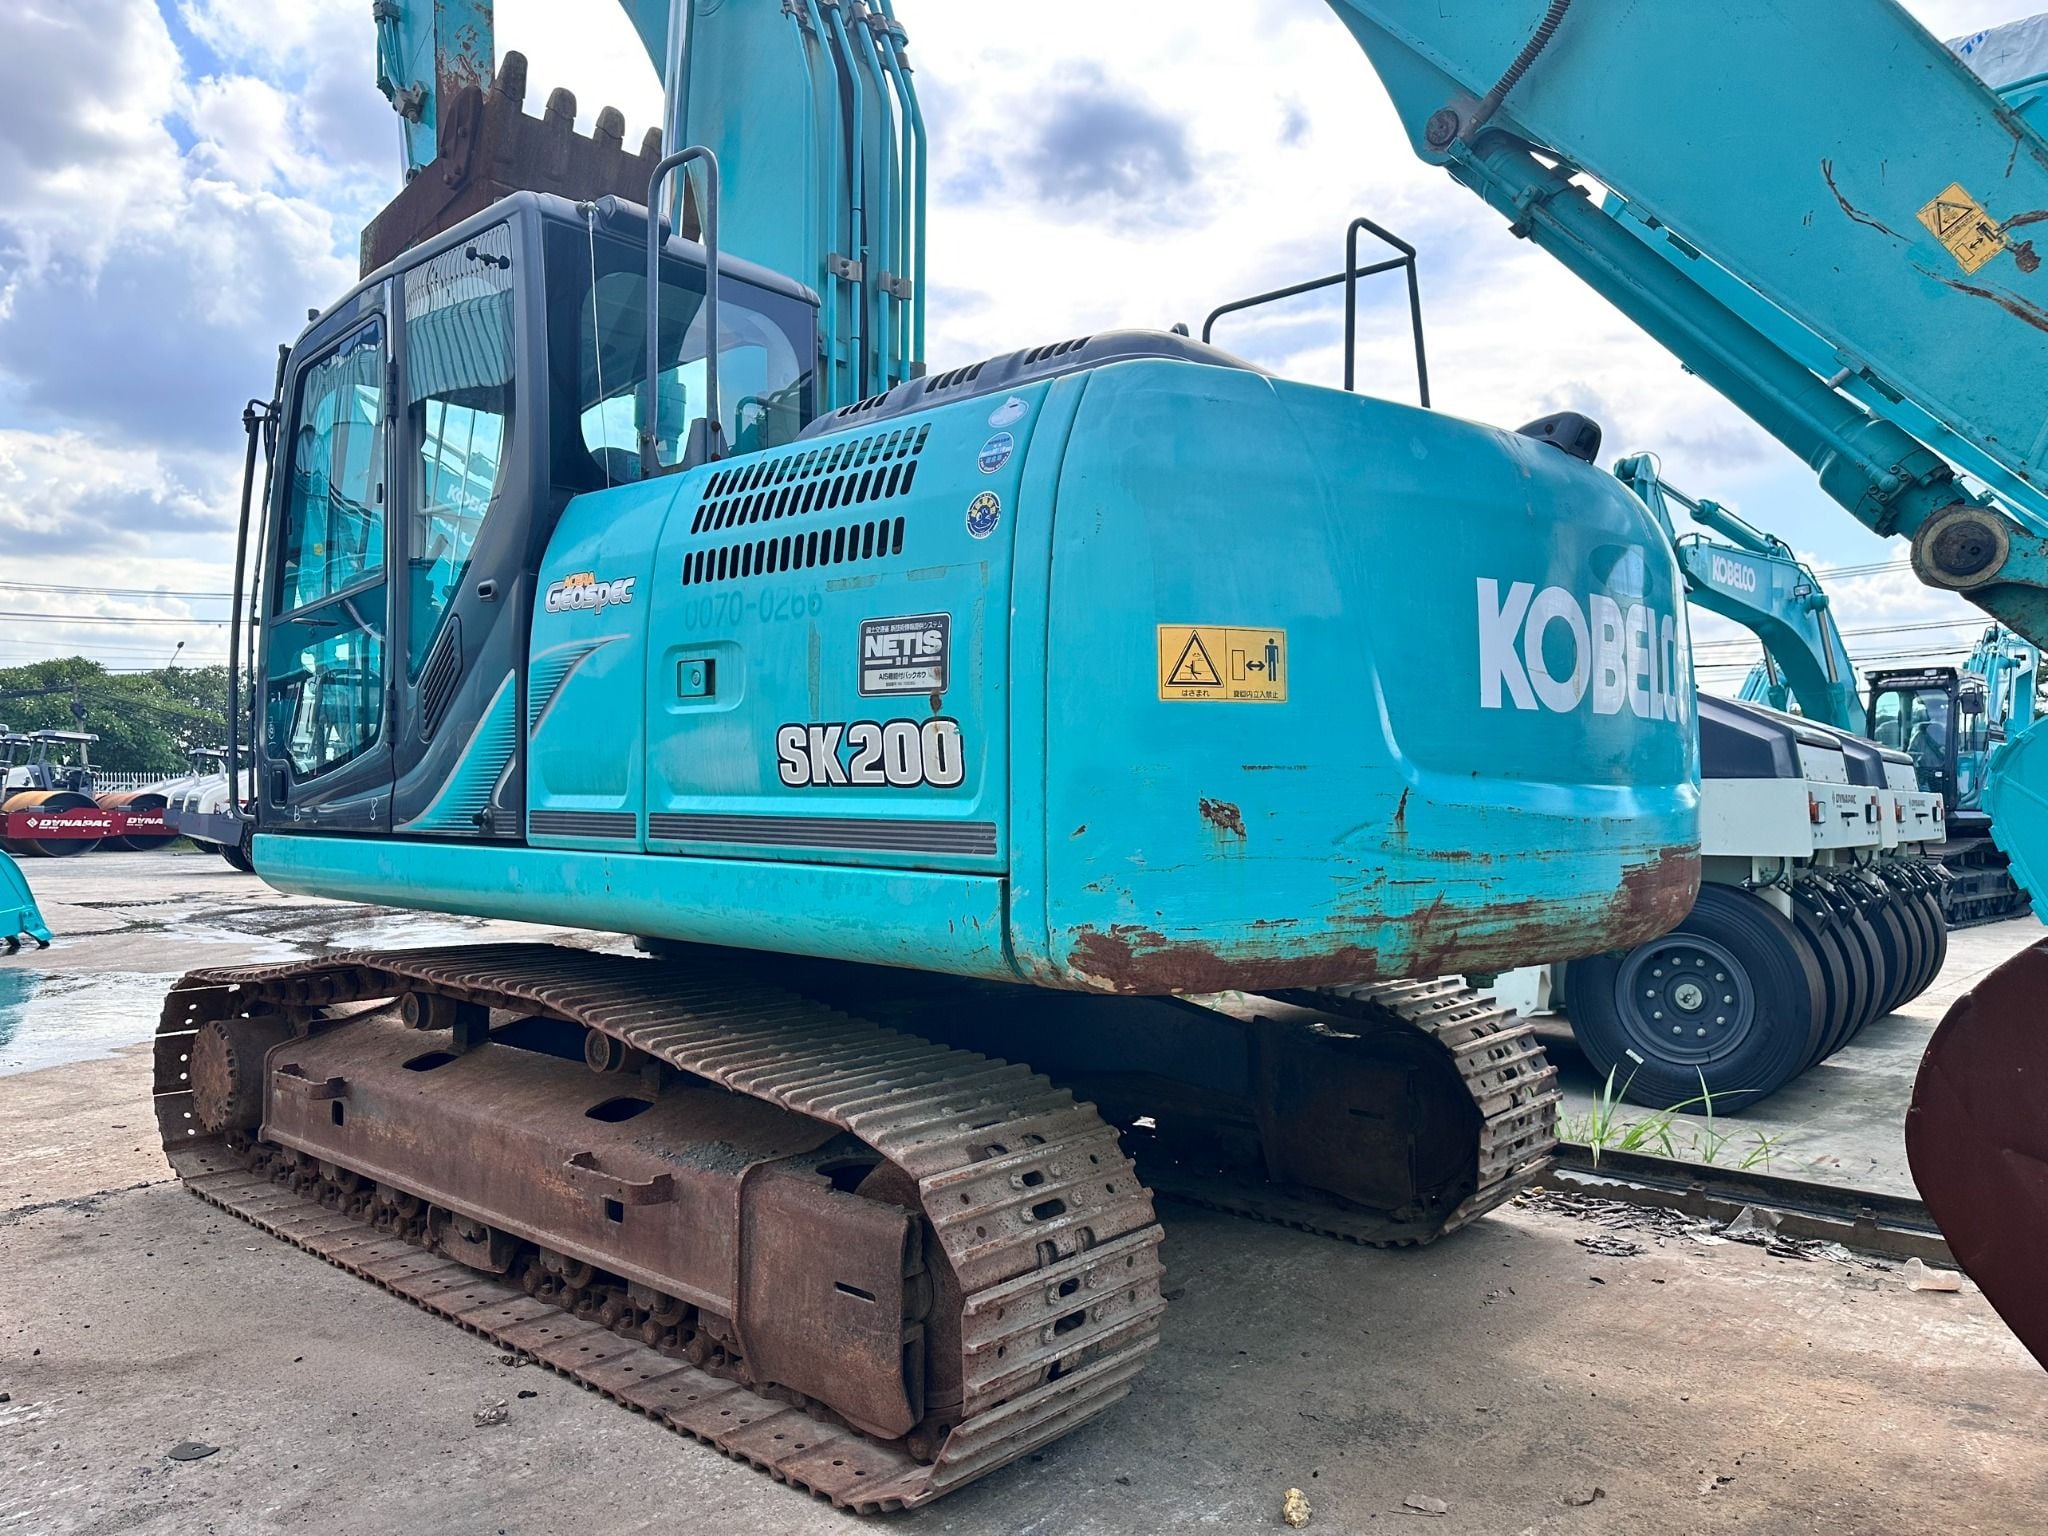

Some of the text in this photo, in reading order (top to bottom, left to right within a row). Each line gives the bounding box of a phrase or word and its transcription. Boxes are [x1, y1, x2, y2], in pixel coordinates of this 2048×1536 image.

[1712, 554, 1756, 592] KOBELCO
[865, 630, 943, 657] NETIS
[1181, 689, 1210, 697] はさまれ
[776, 717, 965, 788] SK200
[39, 818, 112, 828] DYNAPAC
[126, 817, 163, 825] DYNA
